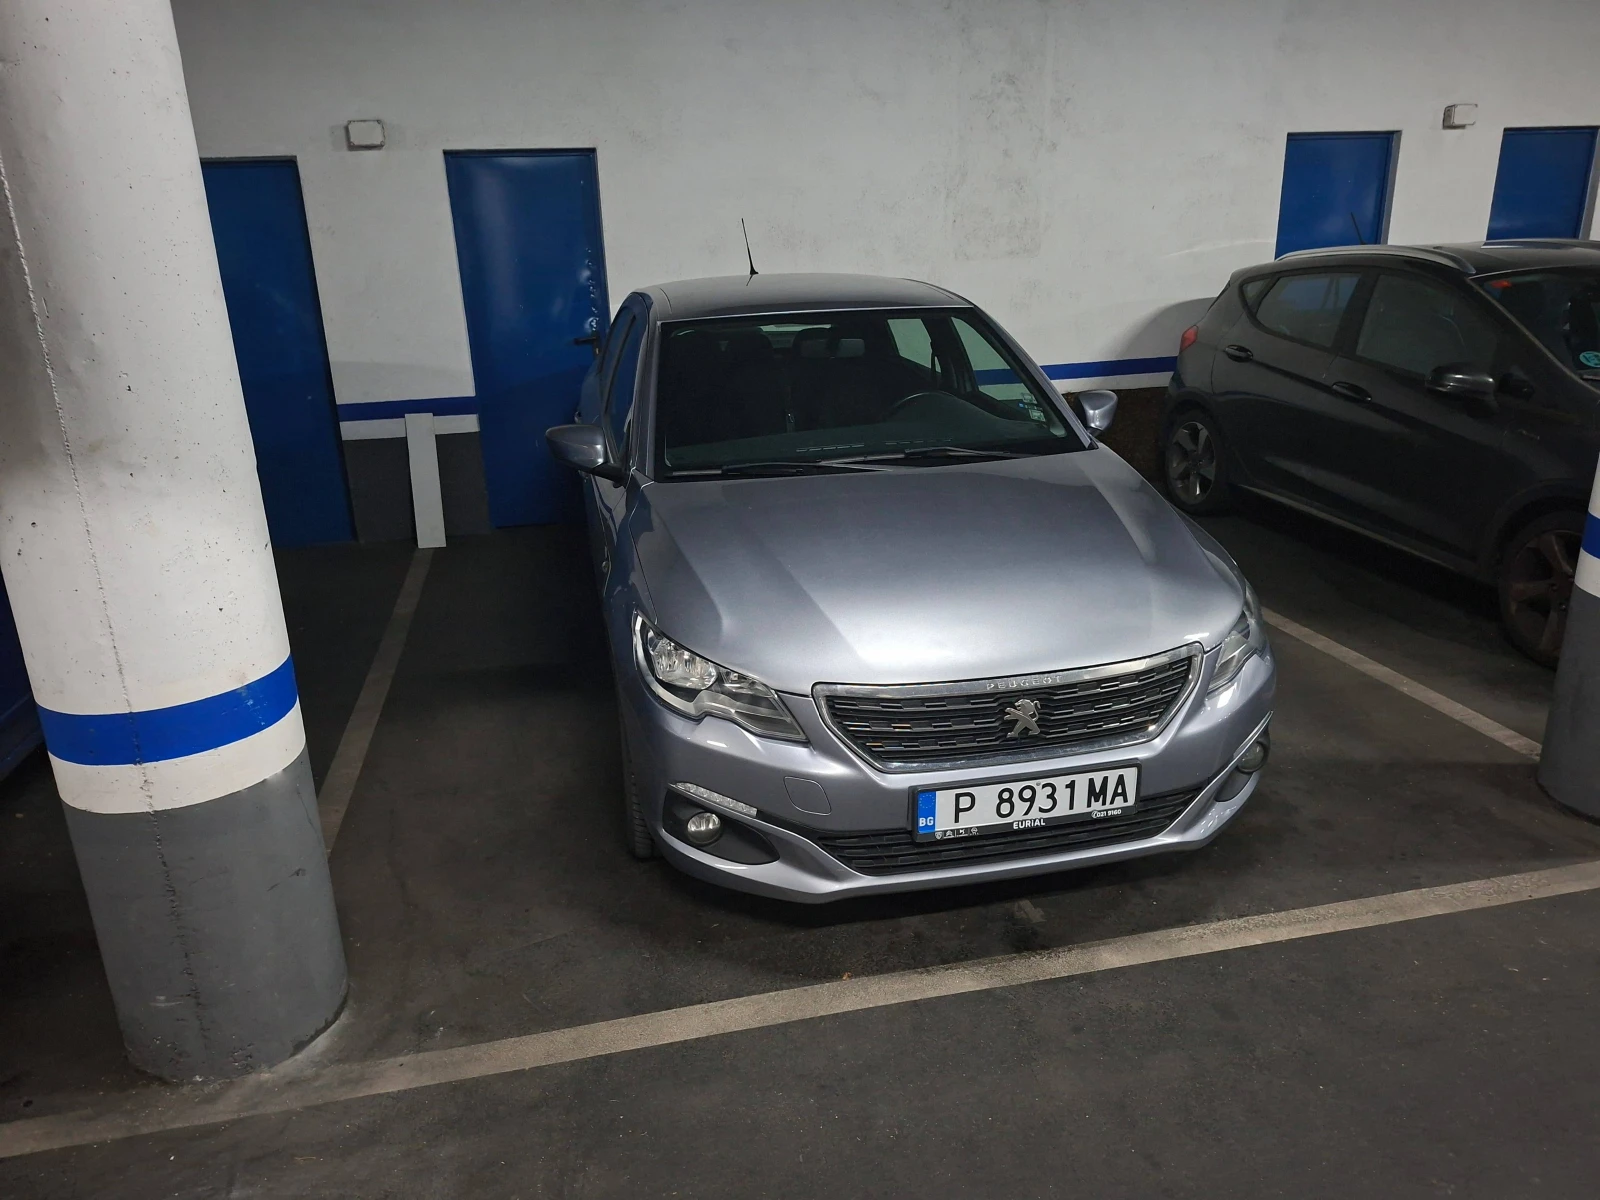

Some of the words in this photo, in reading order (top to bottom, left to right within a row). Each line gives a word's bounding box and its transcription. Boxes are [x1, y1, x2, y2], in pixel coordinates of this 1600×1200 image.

[986, 675, 1062, 690] PEUGEOT
[953, 791, 976, 824] P
[919, 816, 934, 827] BG
